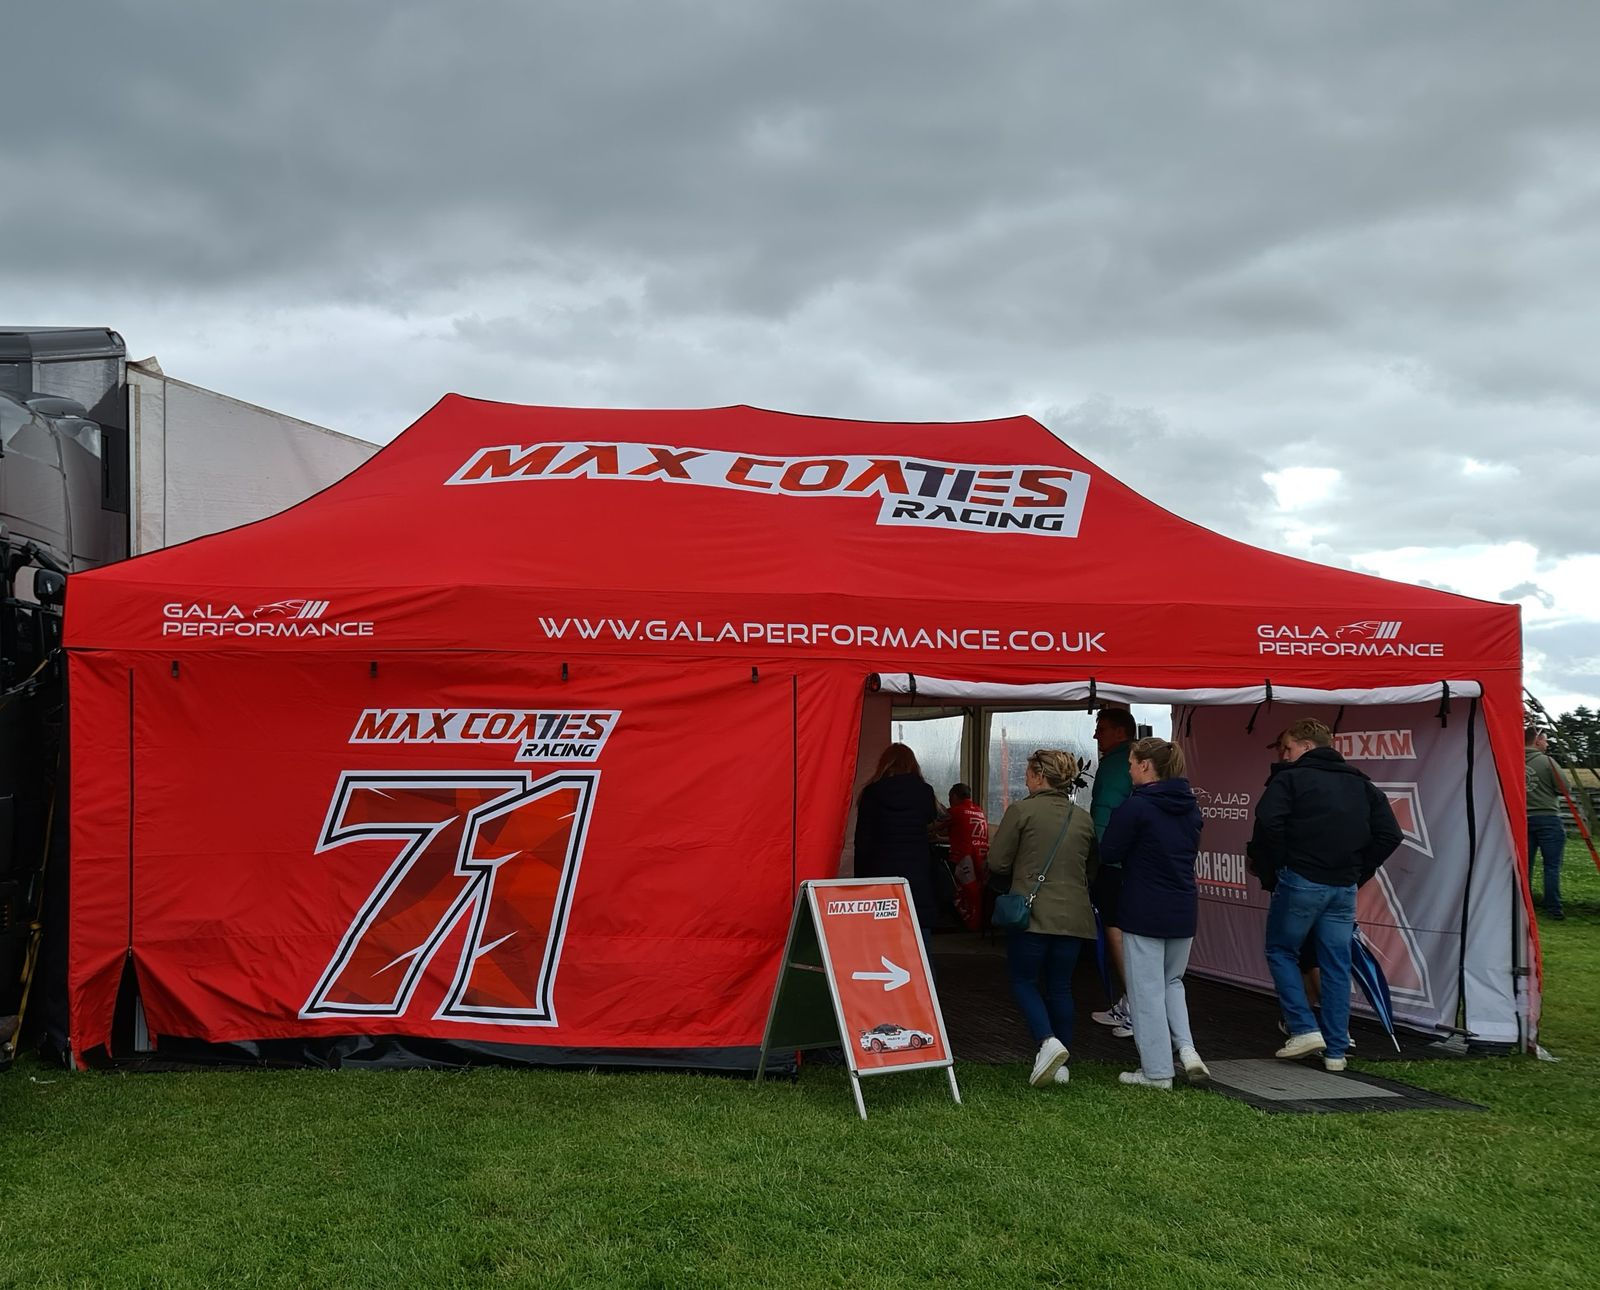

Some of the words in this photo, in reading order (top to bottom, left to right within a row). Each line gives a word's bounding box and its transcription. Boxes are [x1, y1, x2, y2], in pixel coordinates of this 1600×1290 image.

[458, 444, 705, 481] MAX
[725, 456, 1073, 508] COATES
[891, 499, 1065, 532] RACING
[162, 602, 245, 620] GALA
[162, 621, 374, 637] PERFORMANCE
[538, 616, 1107, 653] WWW.GALAPERFORMANCE.CO.UK
[1257, 624, 1330, 640] GALA
[1258, 641, 1445, 657] PERFORMANCE
[354, 712, 458, 740] MAX
[460, 713, 613, 741] COATES
[521, 743, 598, 758] RACING
[298, 770, 601, 1027] 71
[828, 902, 855, 914] MAX
[857, 900, 898, 913] COATES
[875, 910, 897, 918] RACING
